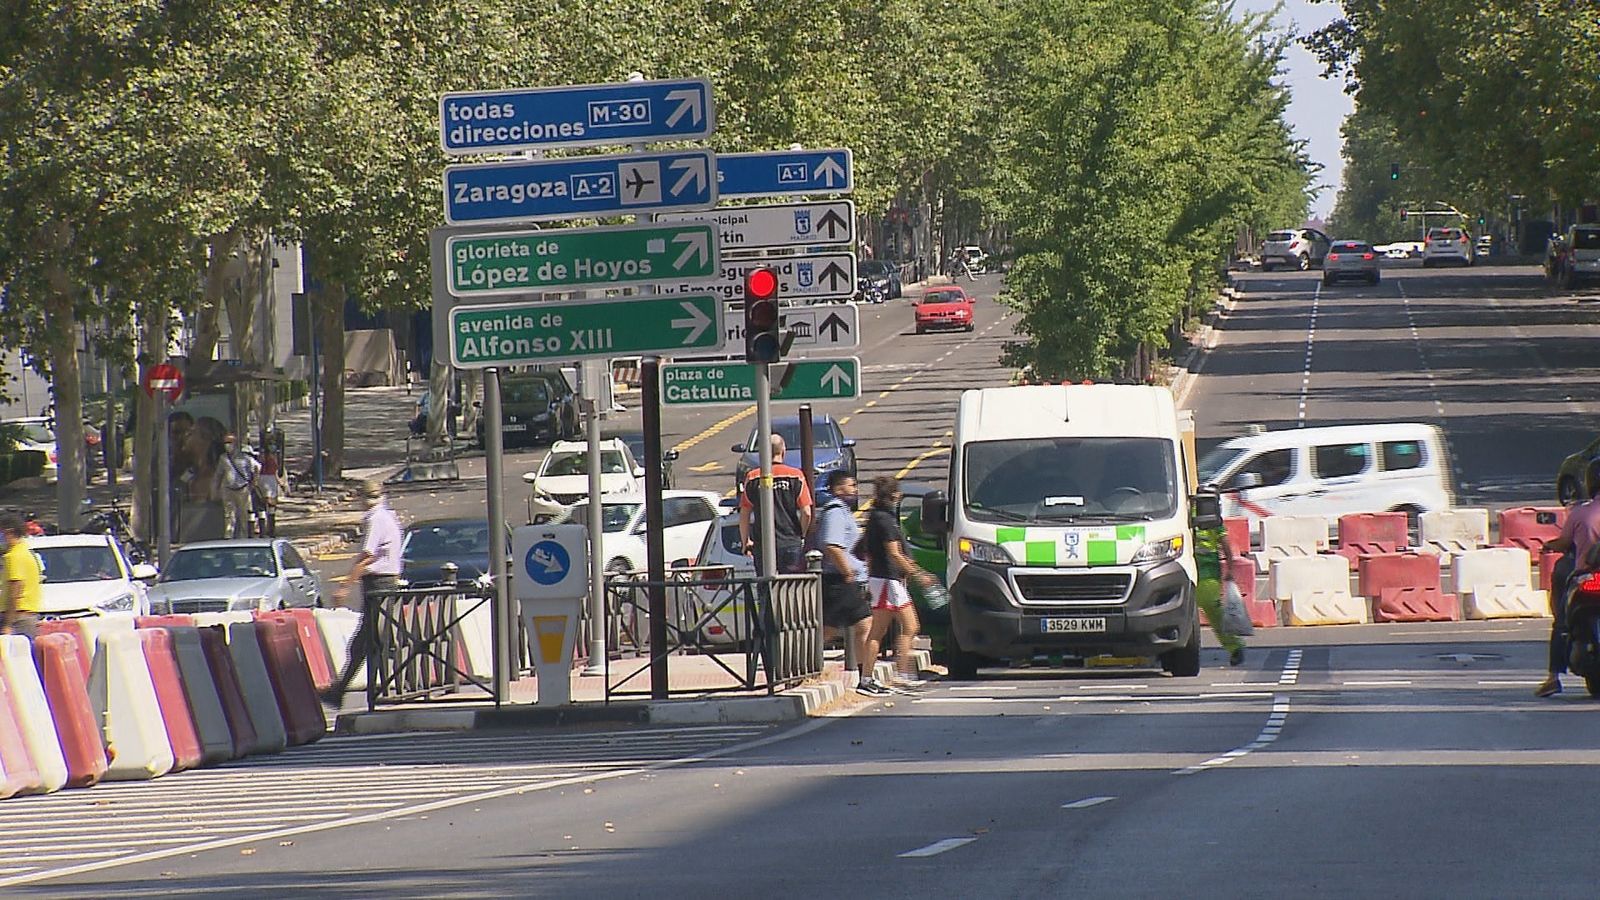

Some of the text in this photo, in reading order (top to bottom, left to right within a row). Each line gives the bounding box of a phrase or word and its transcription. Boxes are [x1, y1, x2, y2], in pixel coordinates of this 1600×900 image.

[450, 101, 515, 121] todas
[592, 103, 647, 123] M-30
[450, 121, 585, 144] direcciones
[781, 165, 806, 180] A-1
[454, 176, 612, 204] Zaragoza A-2
[456, 239, 560, 263] glorieta de
[456, 257, 653, 289] López de Hoyos
[459, 312, 564, 334] avenida de
[461, 328, 613, 359] Alfonso XIII
[665, 368, 724, 384] plaza de
[666, 384, 753, 401] Cataluña
[1048, 619, 1078, 631] 3529
